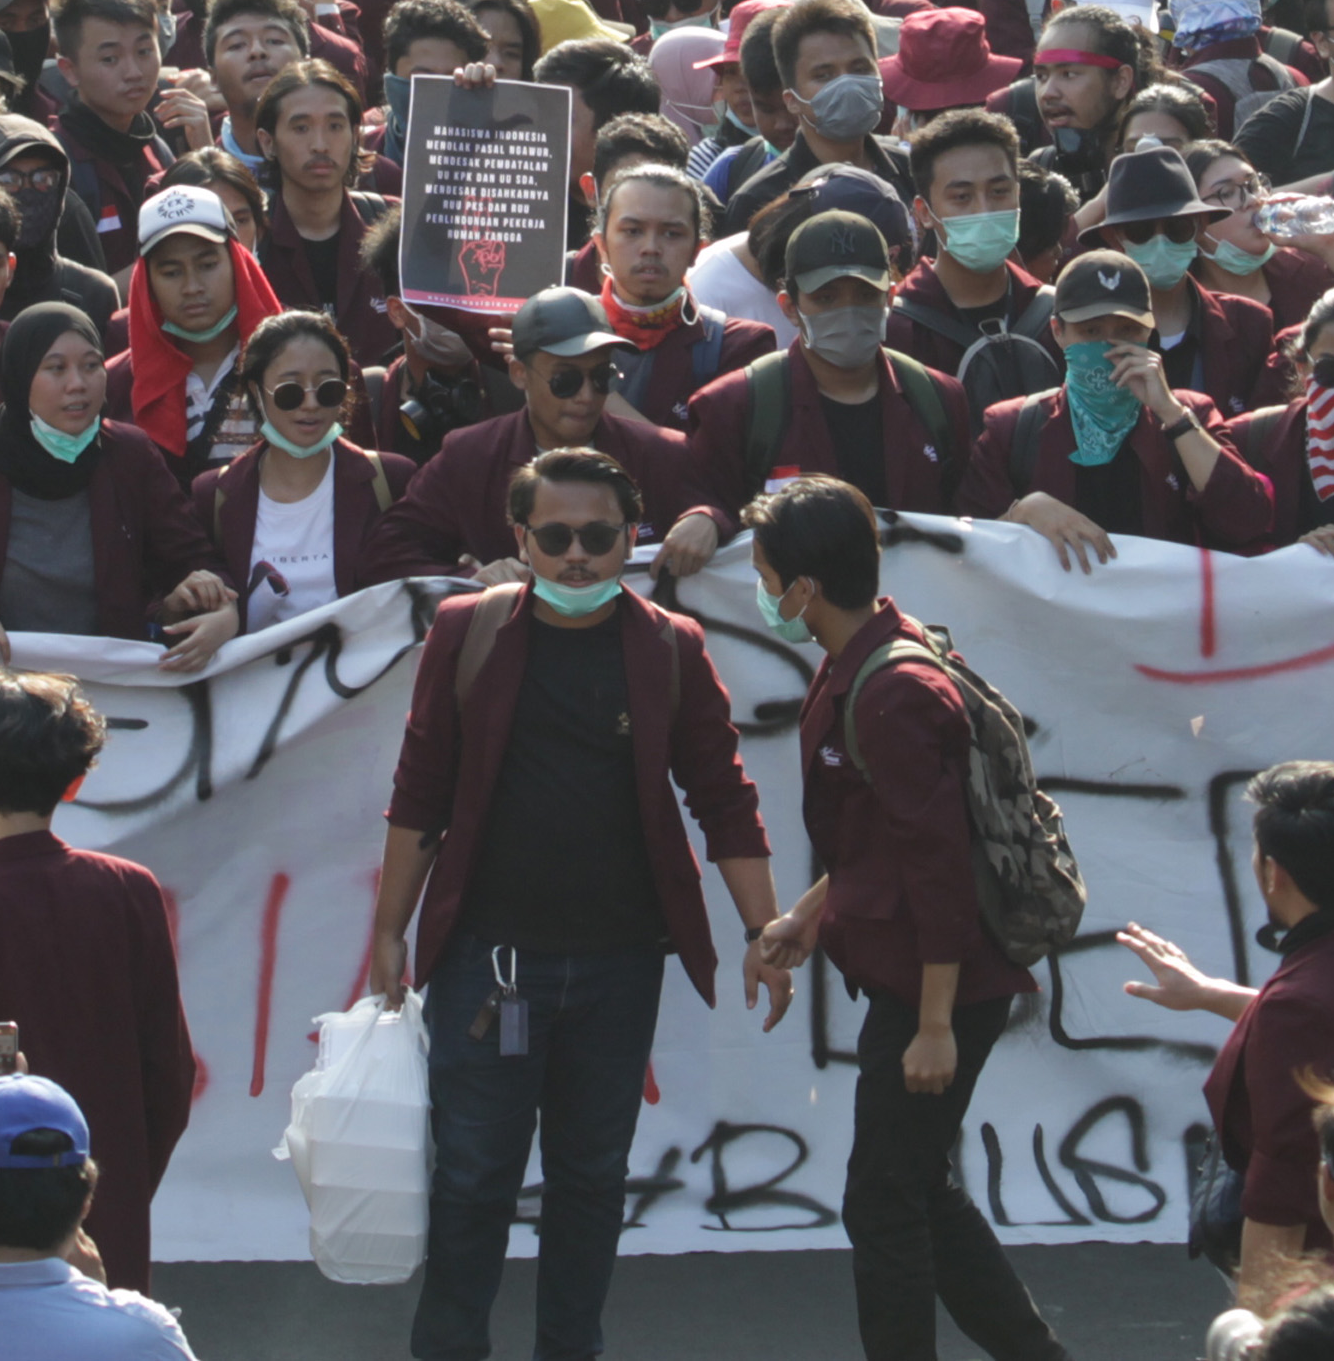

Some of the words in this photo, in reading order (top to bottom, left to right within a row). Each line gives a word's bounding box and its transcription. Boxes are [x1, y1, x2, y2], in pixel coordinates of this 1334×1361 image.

[434, 125, 491, 139] MAHASISWA
[495, 130, 547, 143] INDONESIA
[426, 139, 471, 152] MENOLAK
[475, 143, 505, 155] PASAL
[429, 155, 480, 168] MENDESAK
[484, 158, 548, 172] PEMBATALAN
[437, 170, 450, 180] UU
[453, 171, 473, 183] KPK
[476, 172, 496, 183] DAN
[499, 174, 512, 184] UU
[425, 183, 477, 196] MENDESAK
[480, 187, 549, 201] DISAHKANNYA
[443, 199, 462, 211] RUU
[465, 201, 484, 212] PKS
[488, 202, 507, 213] DAN
[511, 203, 530, 214] RUU
[426, 213, 499, 227] PERLINDUNGAN
[503, 217, 545, 229] PEKERJA
[447, 229, 481, 241] RUMAH
[485, 231, 522, 242] TANGGA
